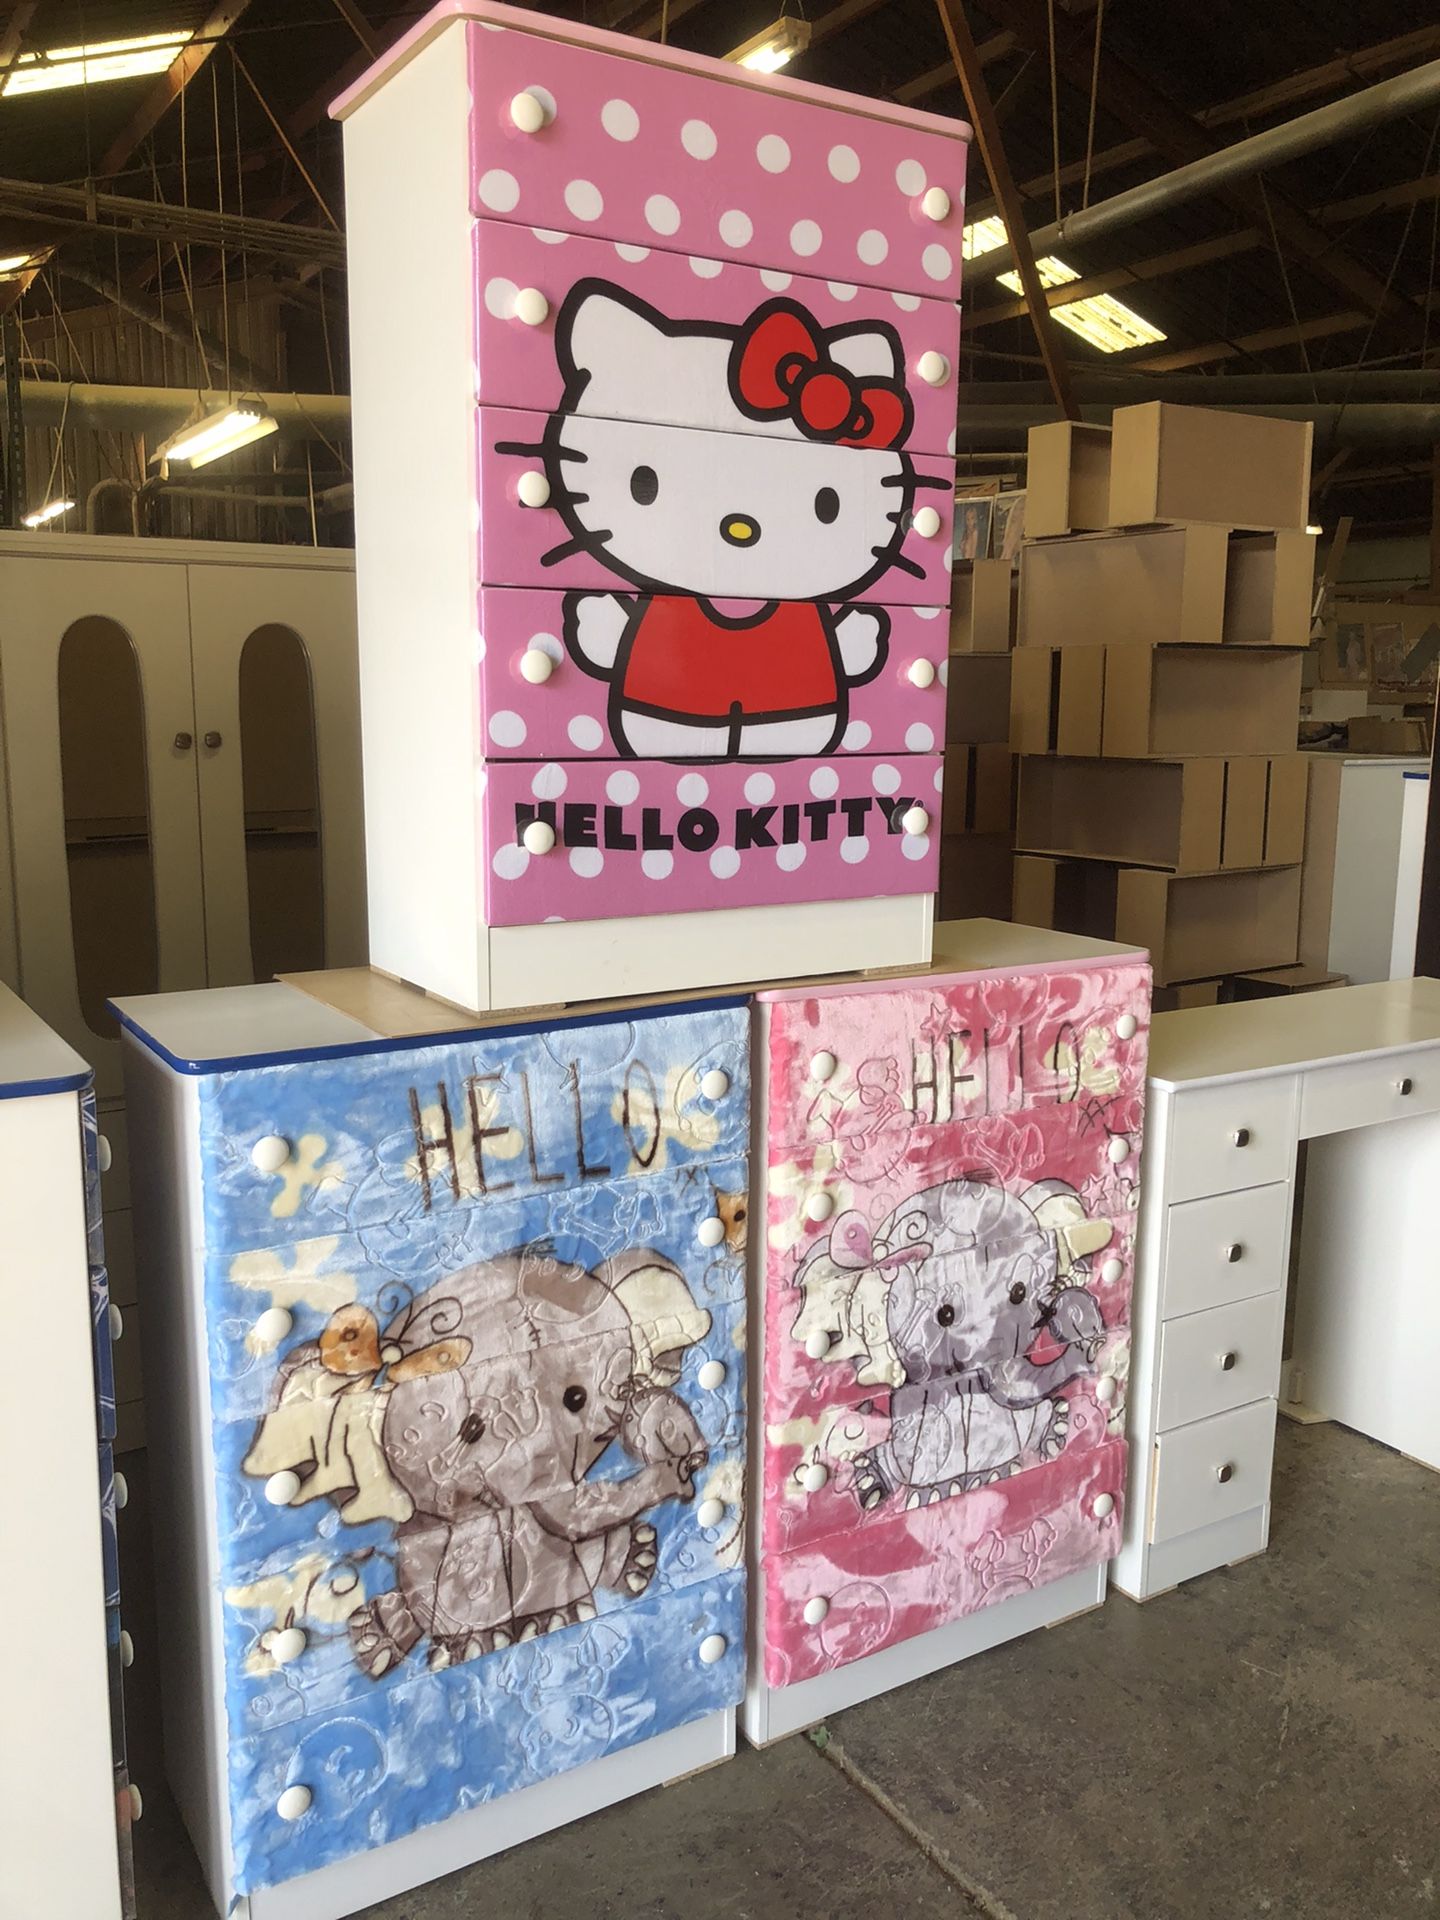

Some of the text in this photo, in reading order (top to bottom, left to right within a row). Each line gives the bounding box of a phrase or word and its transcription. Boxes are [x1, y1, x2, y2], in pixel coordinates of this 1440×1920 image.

[514, 796, 916, 852] HELLO KITTY
[408, 1058, 660, 1211] HELLO
